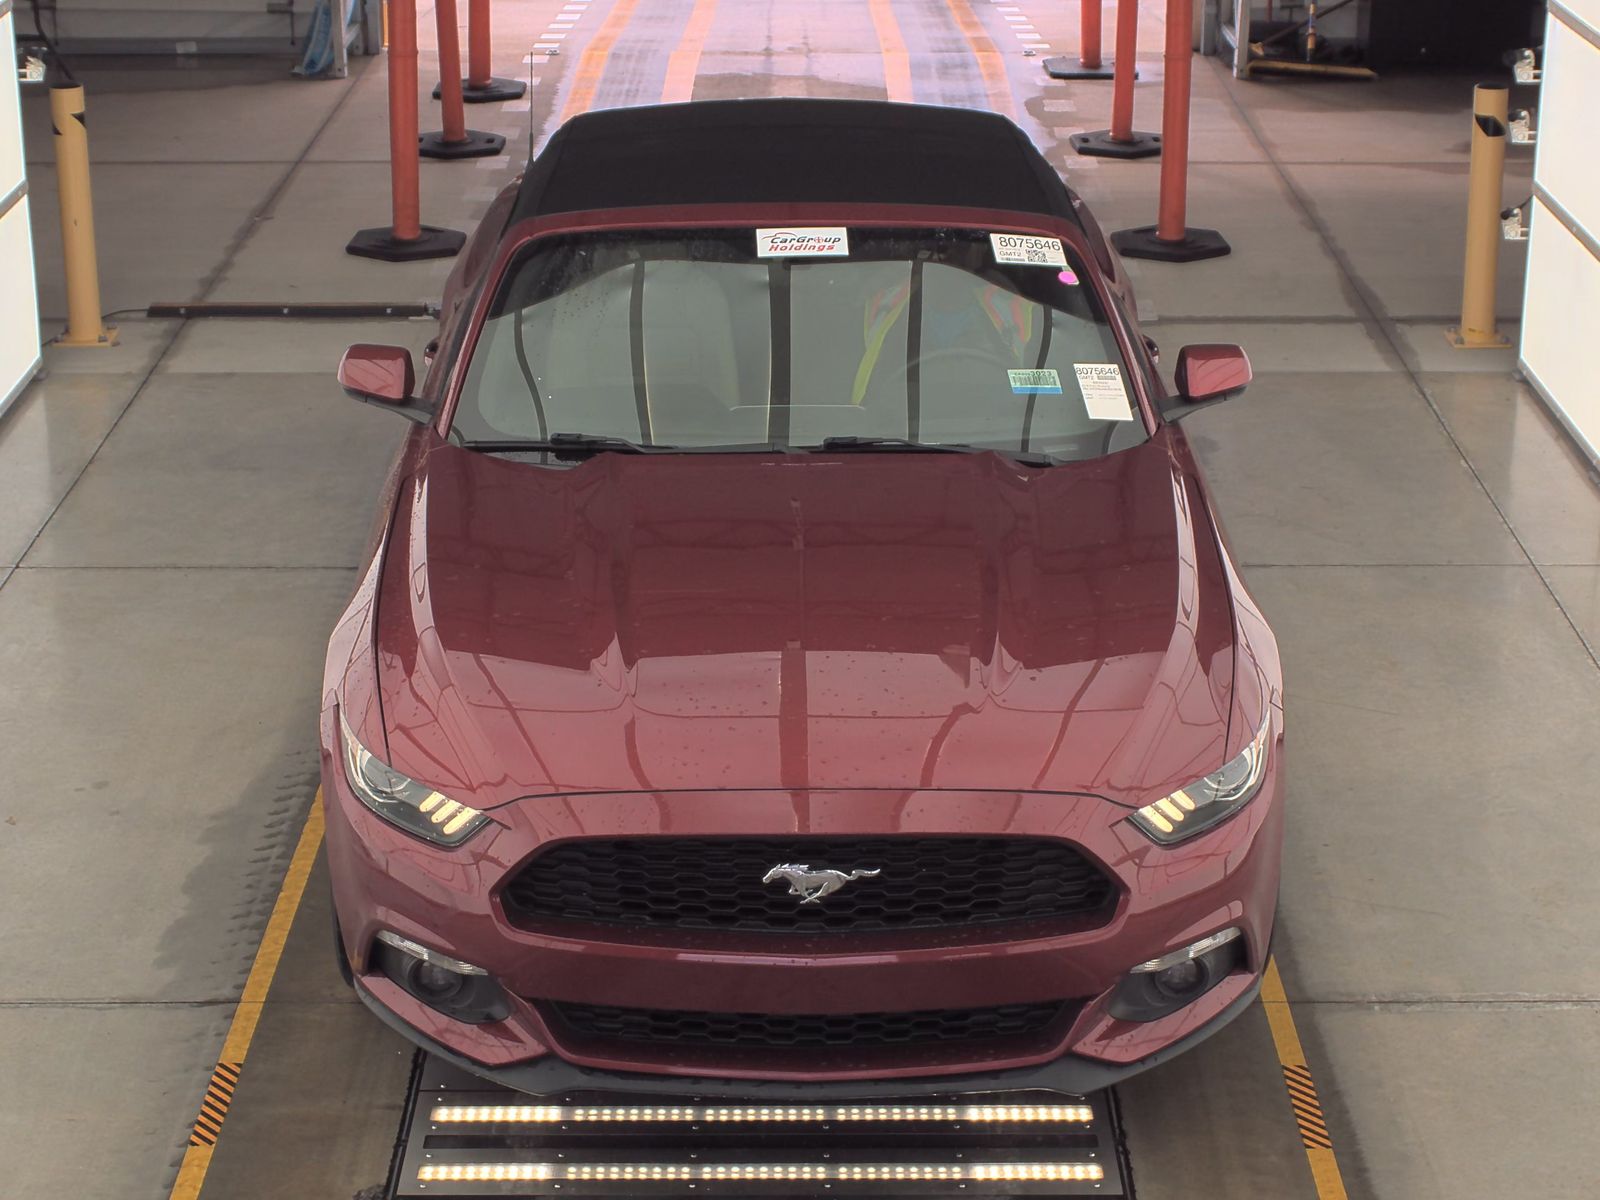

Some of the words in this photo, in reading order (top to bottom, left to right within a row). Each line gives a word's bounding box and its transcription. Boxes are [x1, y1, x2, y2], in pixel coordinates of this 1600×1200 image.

[770, 236, 841, 244] CarGroup
[999, 236, 1061, 251] 8075646
[769, 243, 836, 252] Holdings
[1076, 367, 1119, 375] 8075646
